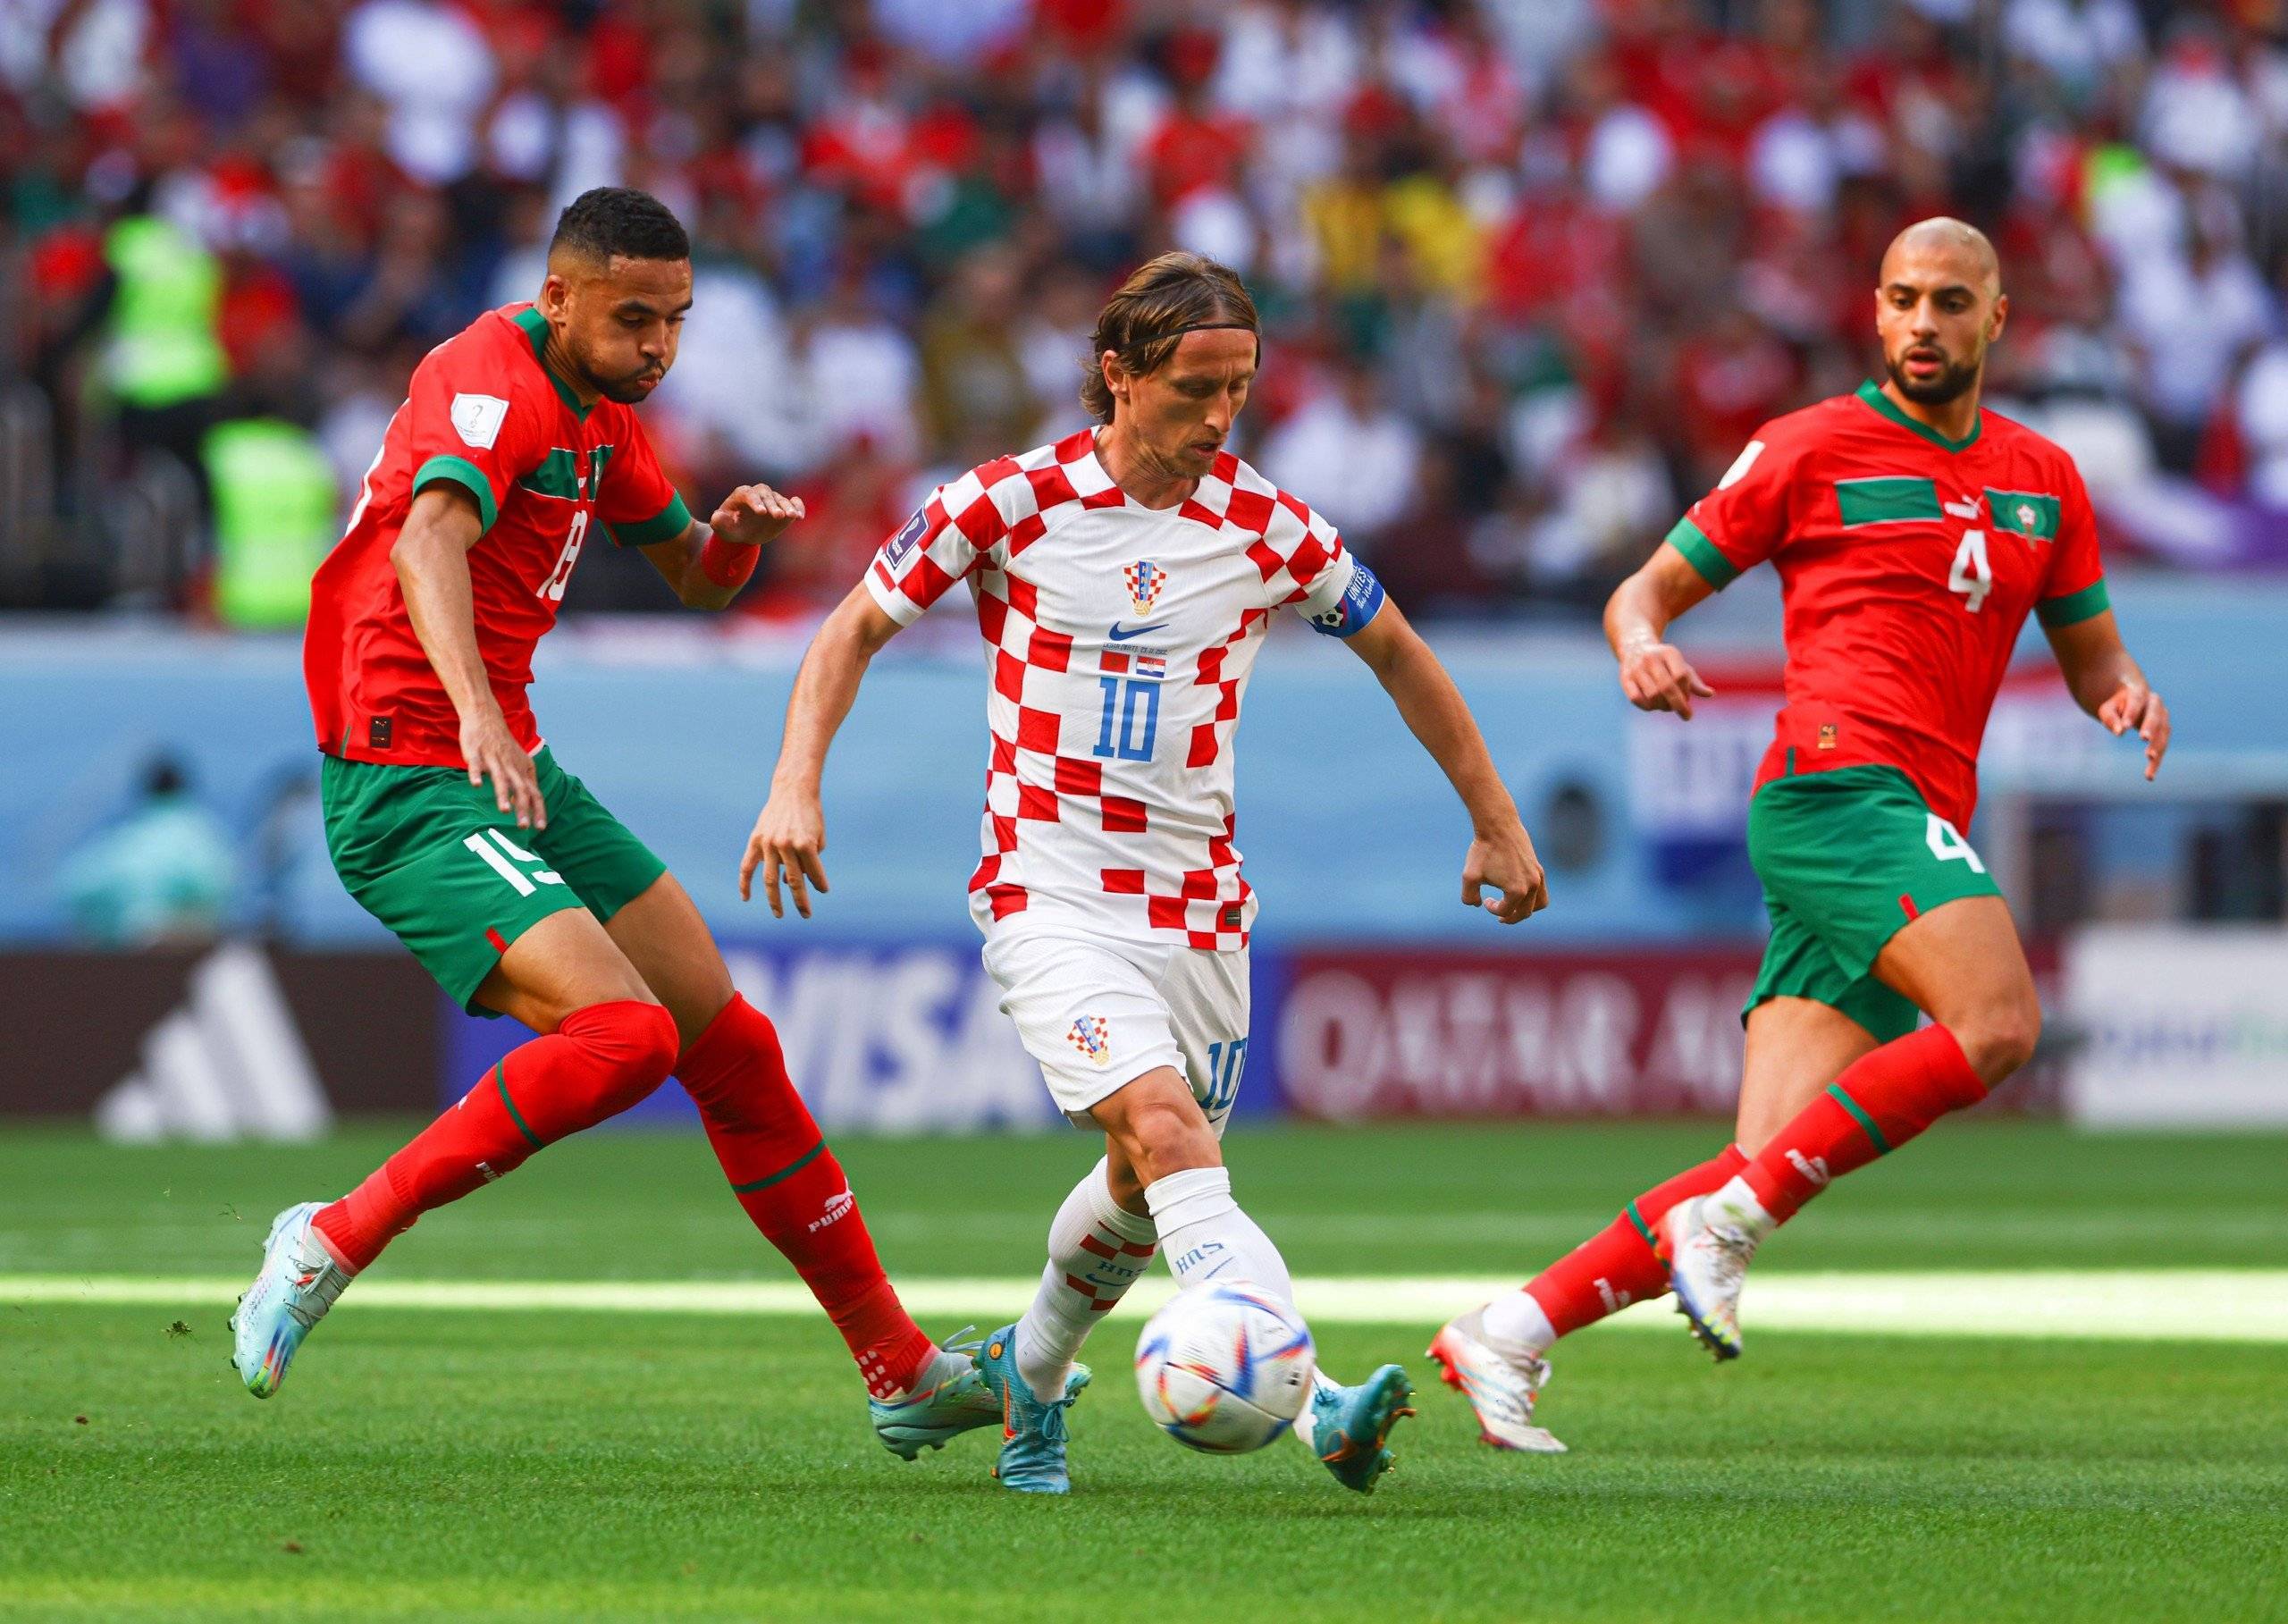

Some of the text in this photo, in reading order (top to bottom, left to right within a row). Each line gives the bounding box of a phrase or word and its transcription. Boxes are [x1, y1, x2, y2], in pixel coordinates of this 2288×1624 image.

[1347, 567, 1367, 602] UNITES
[1948, 528, 1992, 613] 4
[1092, 676, 1161, 762] 10
[1925, 812, 1986, 874] 4
[722, 949, 1056, 1130] VISA
[1197, 1037, 1248, 1110] 10
[1278, 968, 1643, 1123] QATAR
